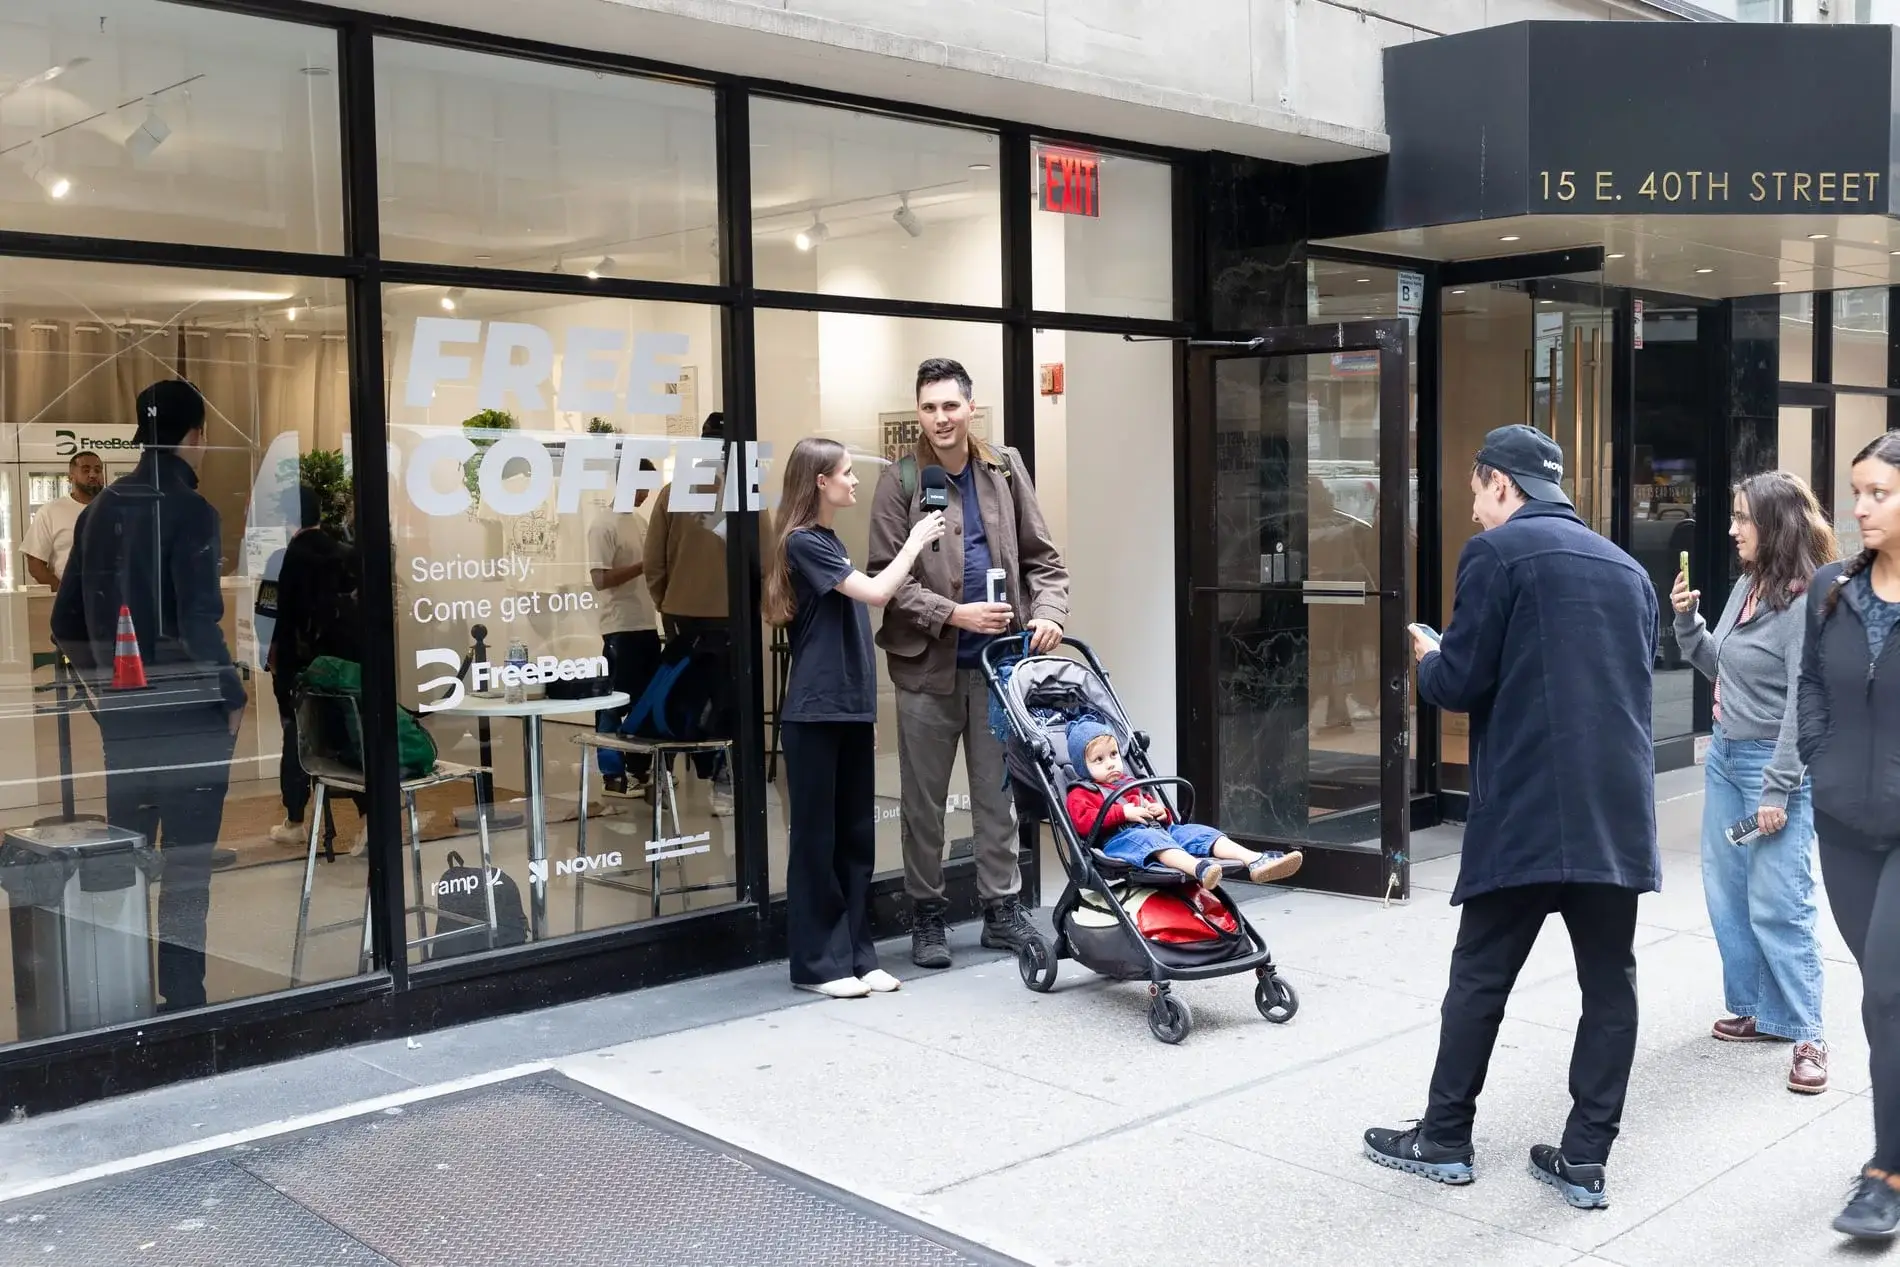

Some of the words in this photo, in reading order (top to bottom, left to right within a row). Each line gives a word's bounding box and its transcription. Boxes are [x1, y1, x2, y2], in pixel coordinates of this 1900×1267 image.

[1045, 154, 1094, 217] EXIT
[1540, 171, 1576, 201] 15
[1596, 171, 1622, 201] E.
[1638, 171, 1729, 202] 40TH
[1749, 171, 1881, 202] STREET
[1402, 285, 1410, 301] B
[405, 316, 690, 414] FREE
[80, 437, 141, 450] FreeBea
[884, 420, 919, 445] FREE
[406, 433, 774, 517] COFFEE
[411, 554, 535, 583] Seriously.
[413, 597, 492, 624] Come
[501, 592, 540, 622] get
[549, 589, 599, 612] one.
[471, 653, 609, 691] FreeBean
[431, 875, 479, 897] ramp
[556, 851, 623, 876] NOVIG
